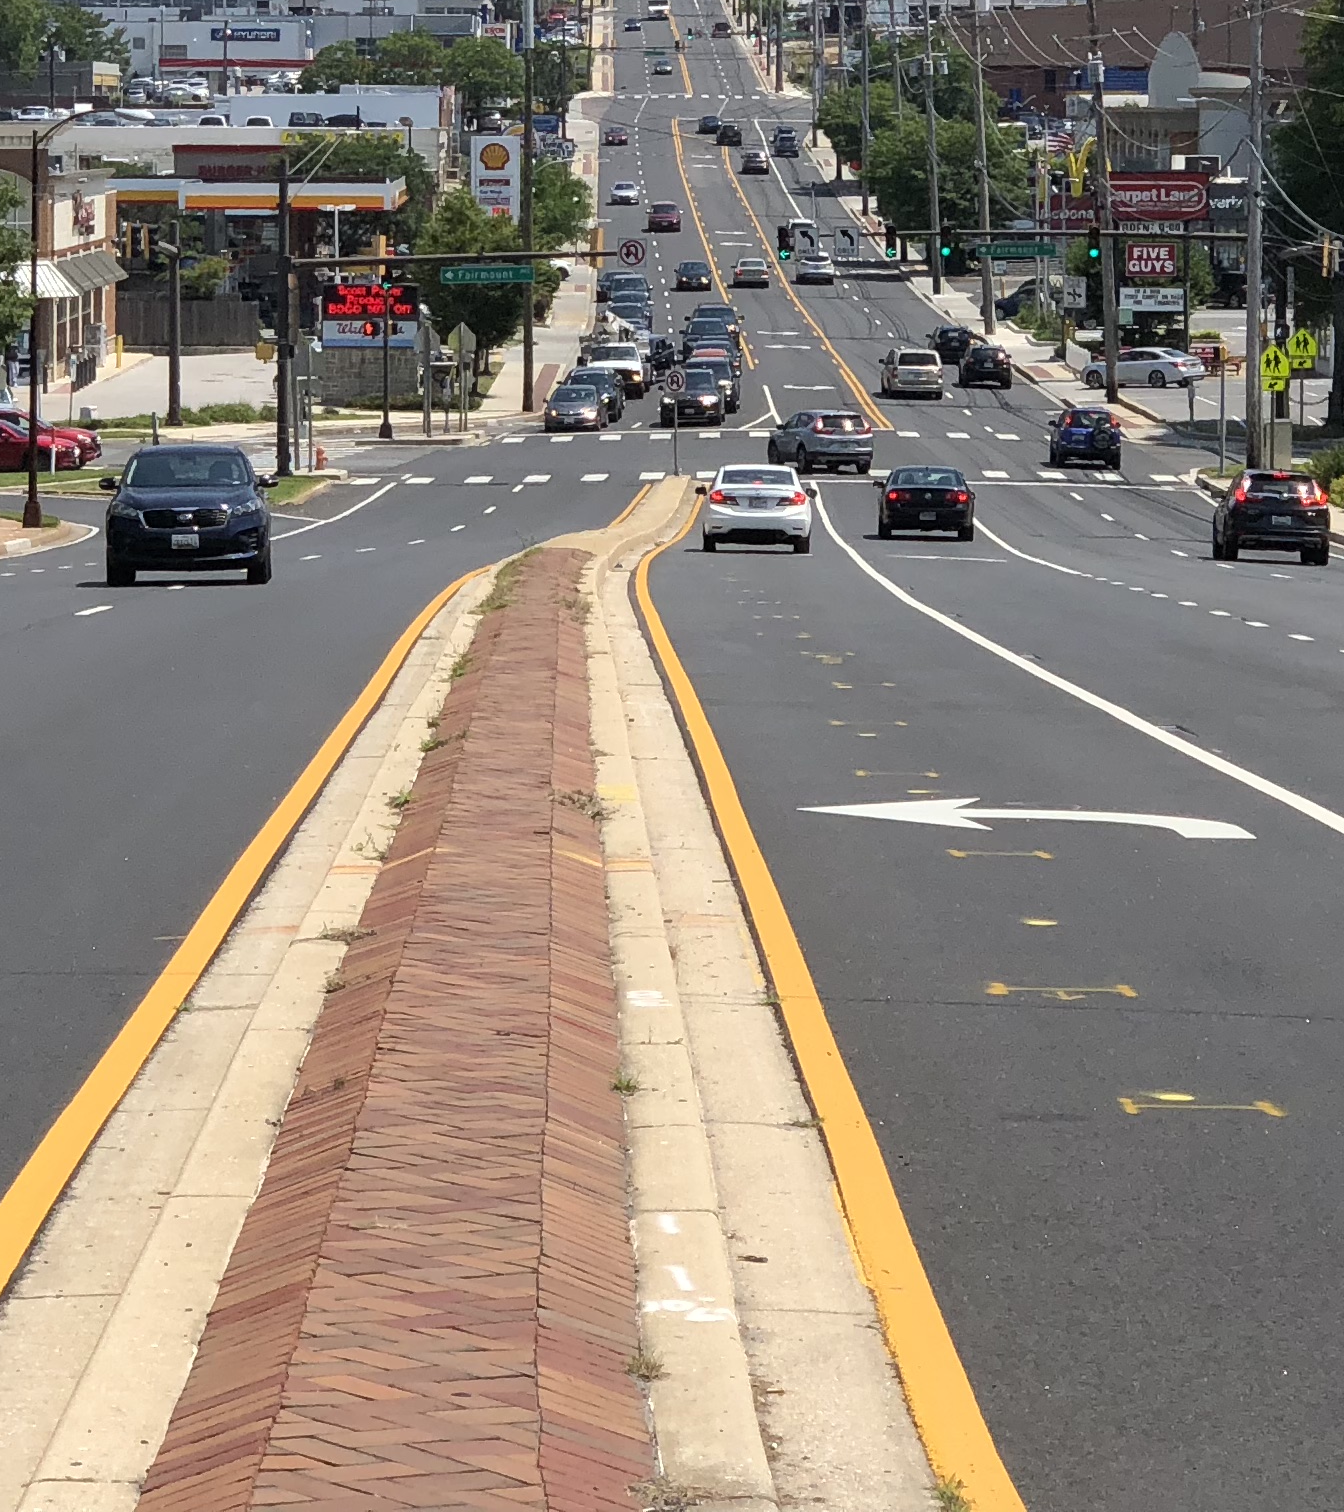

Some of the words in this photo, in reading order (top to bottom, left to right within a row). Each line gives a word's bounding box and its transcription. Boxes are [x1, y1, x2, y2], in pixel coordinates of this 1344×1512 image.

[234, 31, 276, 39] HYUNDAI
[1161, 188, 1199, 202] Land
[1132, 247, 1170, 259] FIVE
[1128, 260, 1174, 273] GUYS
[458, 270, 514, 280] Fairmount
[346, 295, 395, 305] Producs
